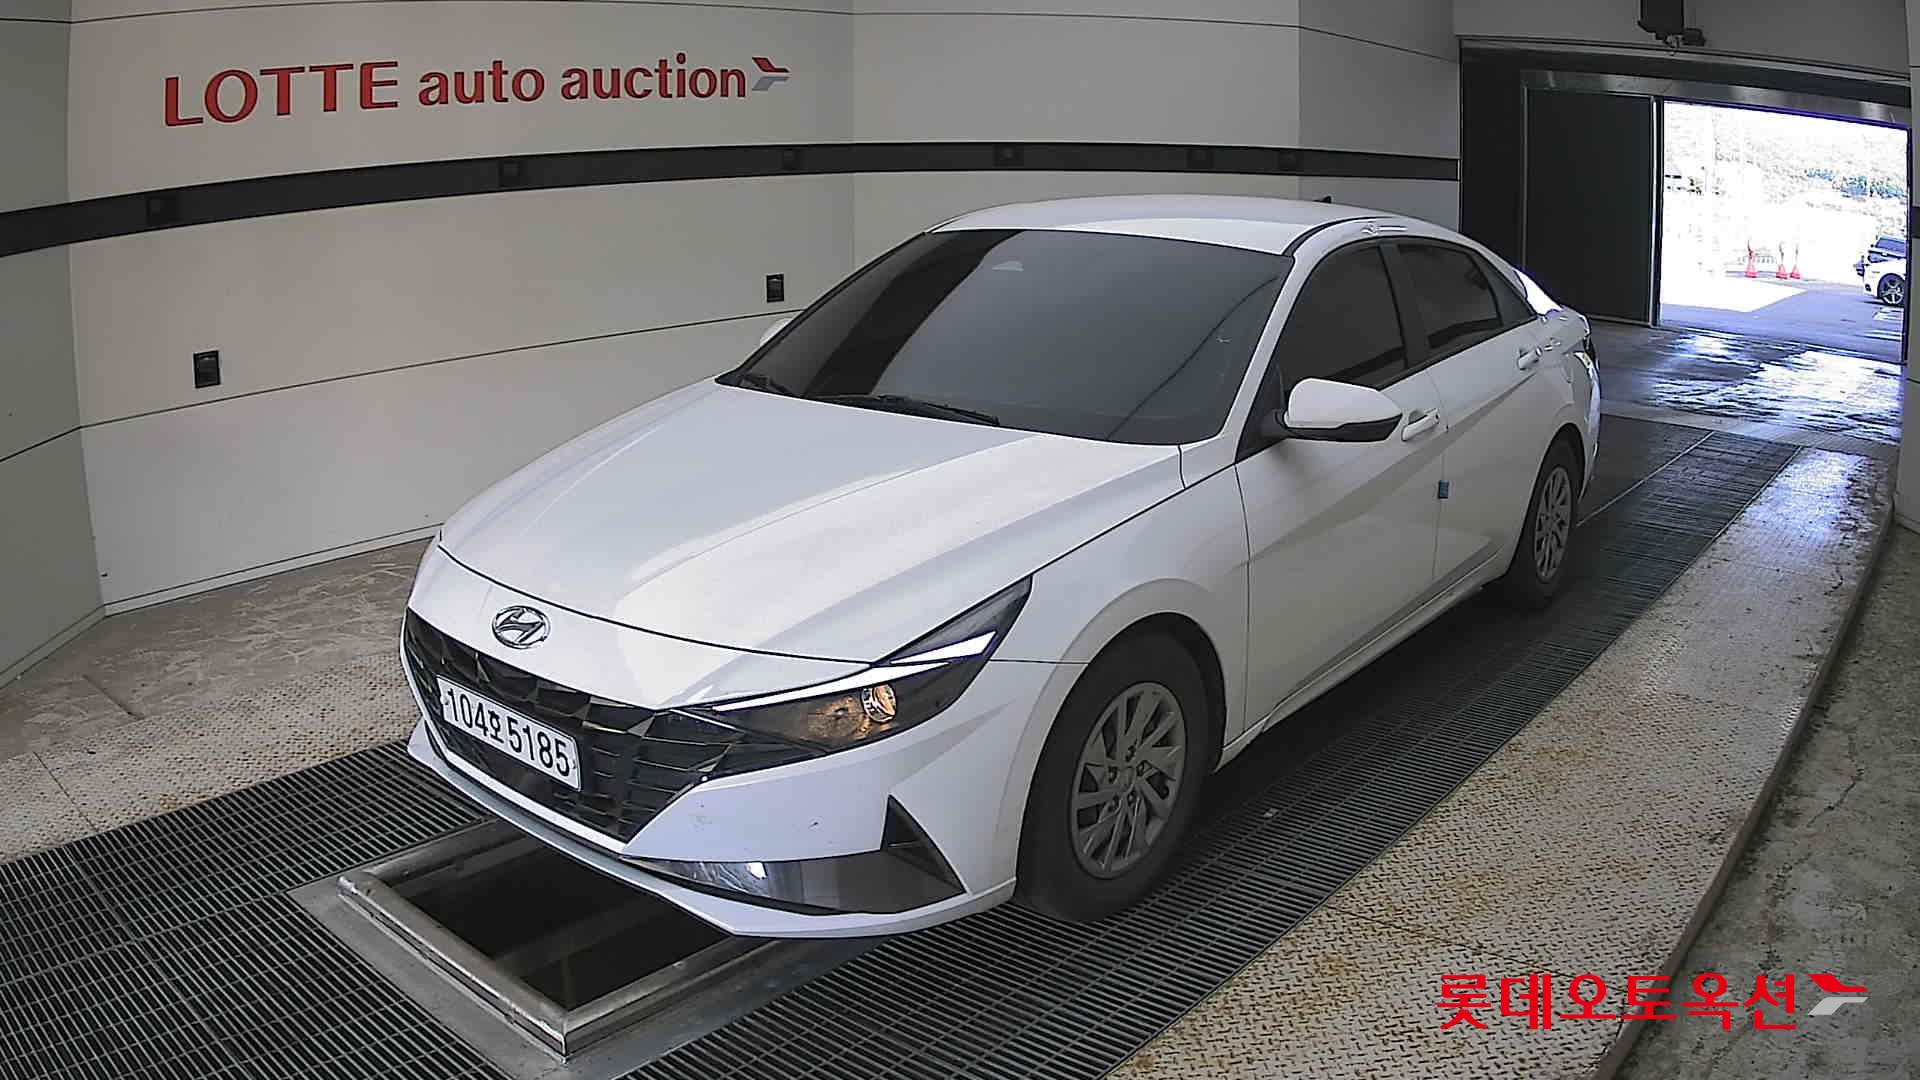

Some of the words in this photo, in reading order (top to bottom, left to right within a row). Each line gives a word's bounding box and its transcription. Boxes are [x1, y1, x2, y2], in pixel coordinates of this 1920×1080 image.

[164, 60, 399, 127] LOTTE
[417, 60, 546, 106] auto
[560, 52, 747, 100] auction
[507, 715, 570, 777] 5185
